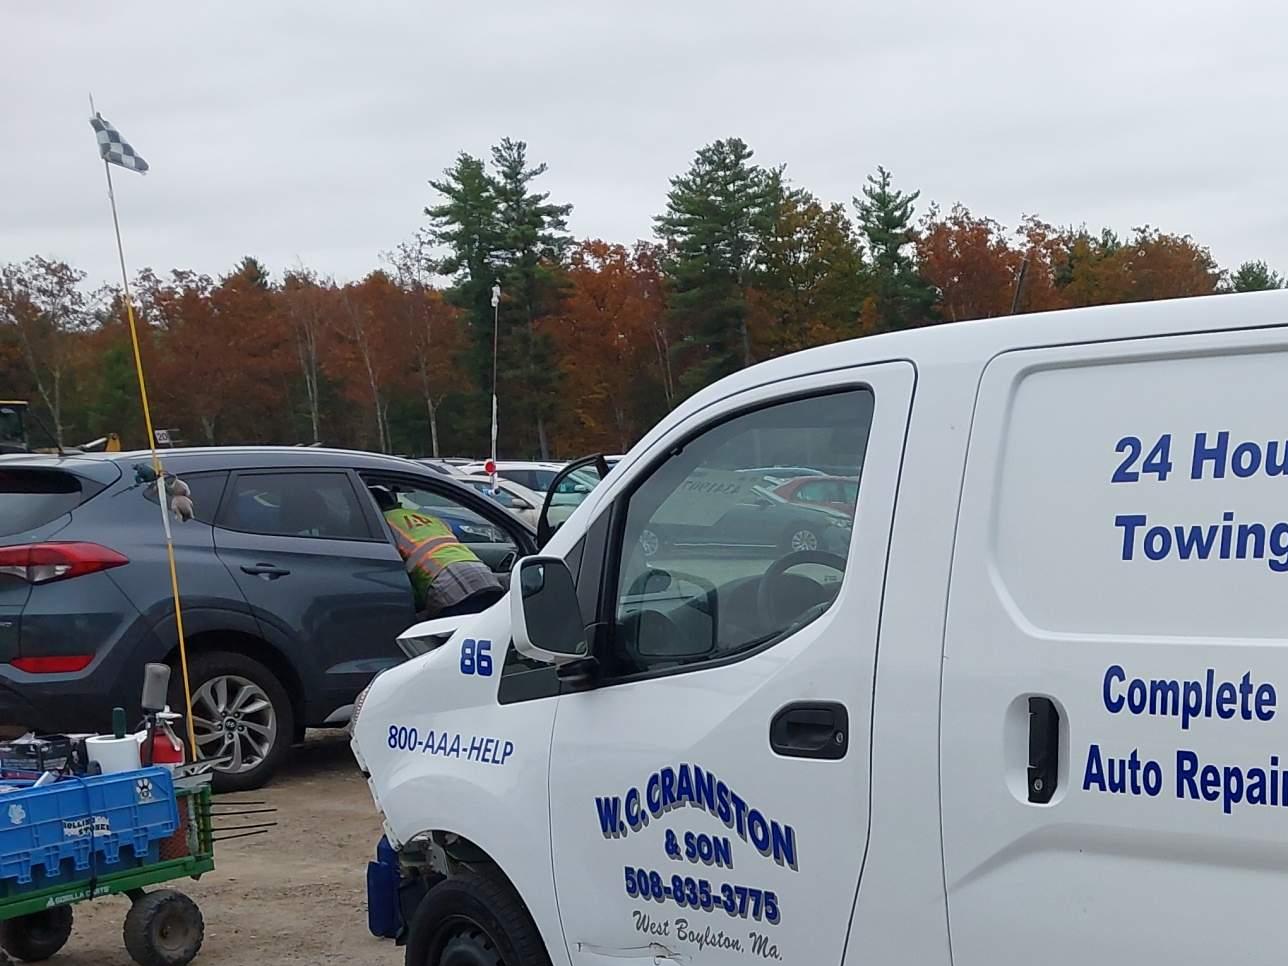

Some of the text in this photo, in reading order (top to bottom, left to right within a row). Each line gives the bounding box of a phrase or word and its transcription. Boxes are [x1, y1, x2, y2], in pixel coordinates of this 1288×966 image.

[1112, 434, 1172, 483] 24
[460, 639, 494, 677] 86
[1103, 665, 1276, 729] Complete
[387, 724, 514, 765] 800-AAA-HELP
[1083, 743, 1163, 796] Auto
[664, 829, 734, 869] & SON
[624, 866, 781, 925] 508-835-3775
[632, 910, 670, 937] West
[749, 932, 784, 961] Ma.
